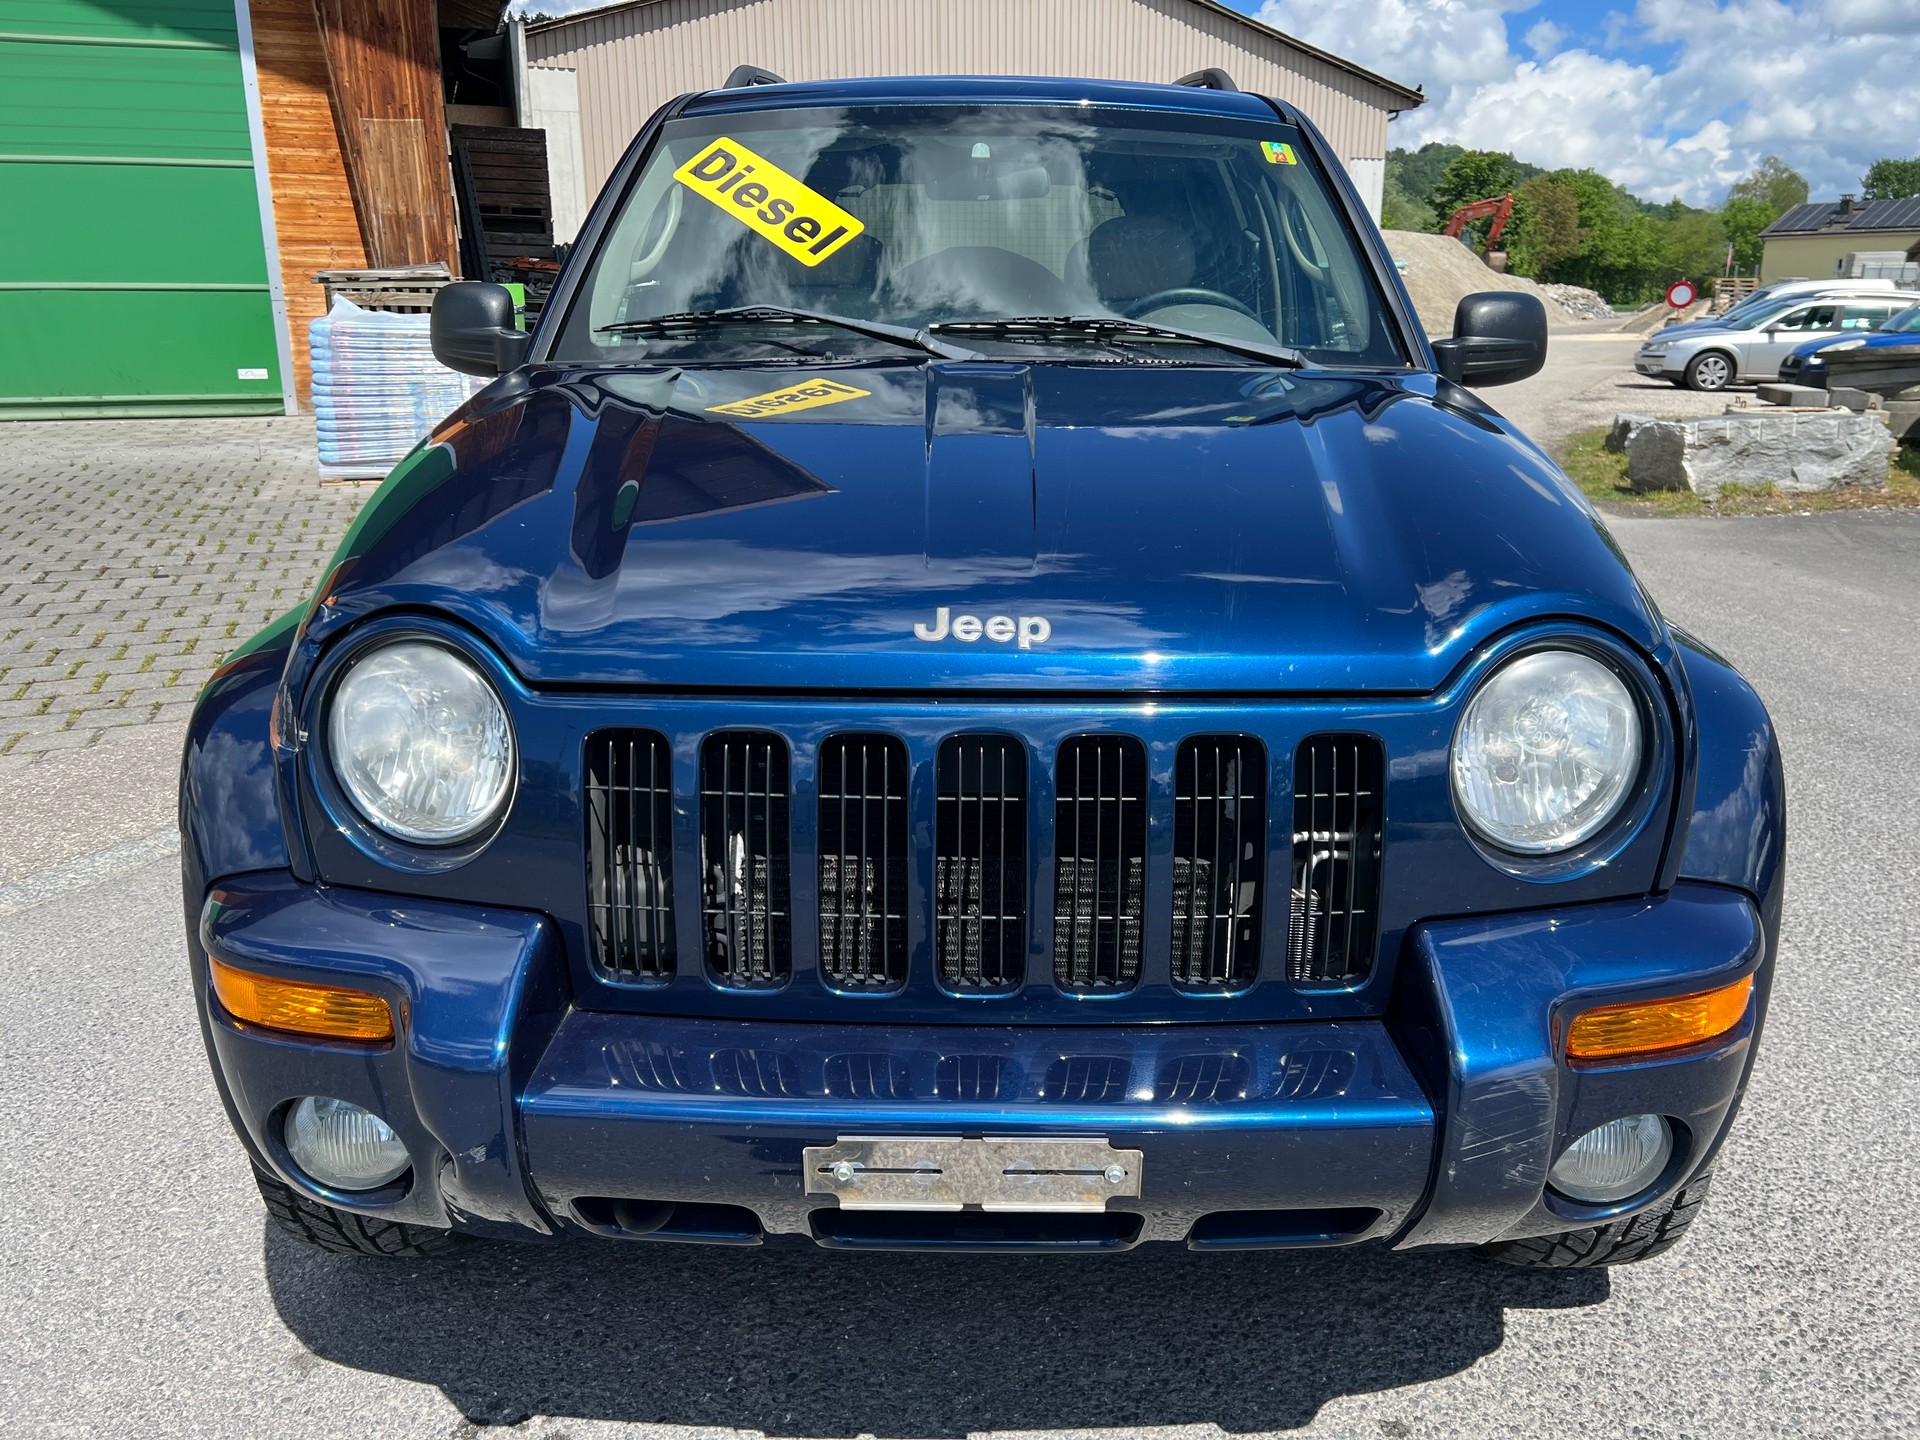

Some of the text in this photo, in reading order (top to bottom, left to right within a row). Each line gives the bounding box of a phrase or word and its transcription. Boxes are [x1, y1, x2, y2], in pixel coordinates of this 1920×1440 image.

[1273, 151, 1288, 162] 23
[688, 148, 848, 255] Diesel
[913, 607, 1051, 649] Jeep
